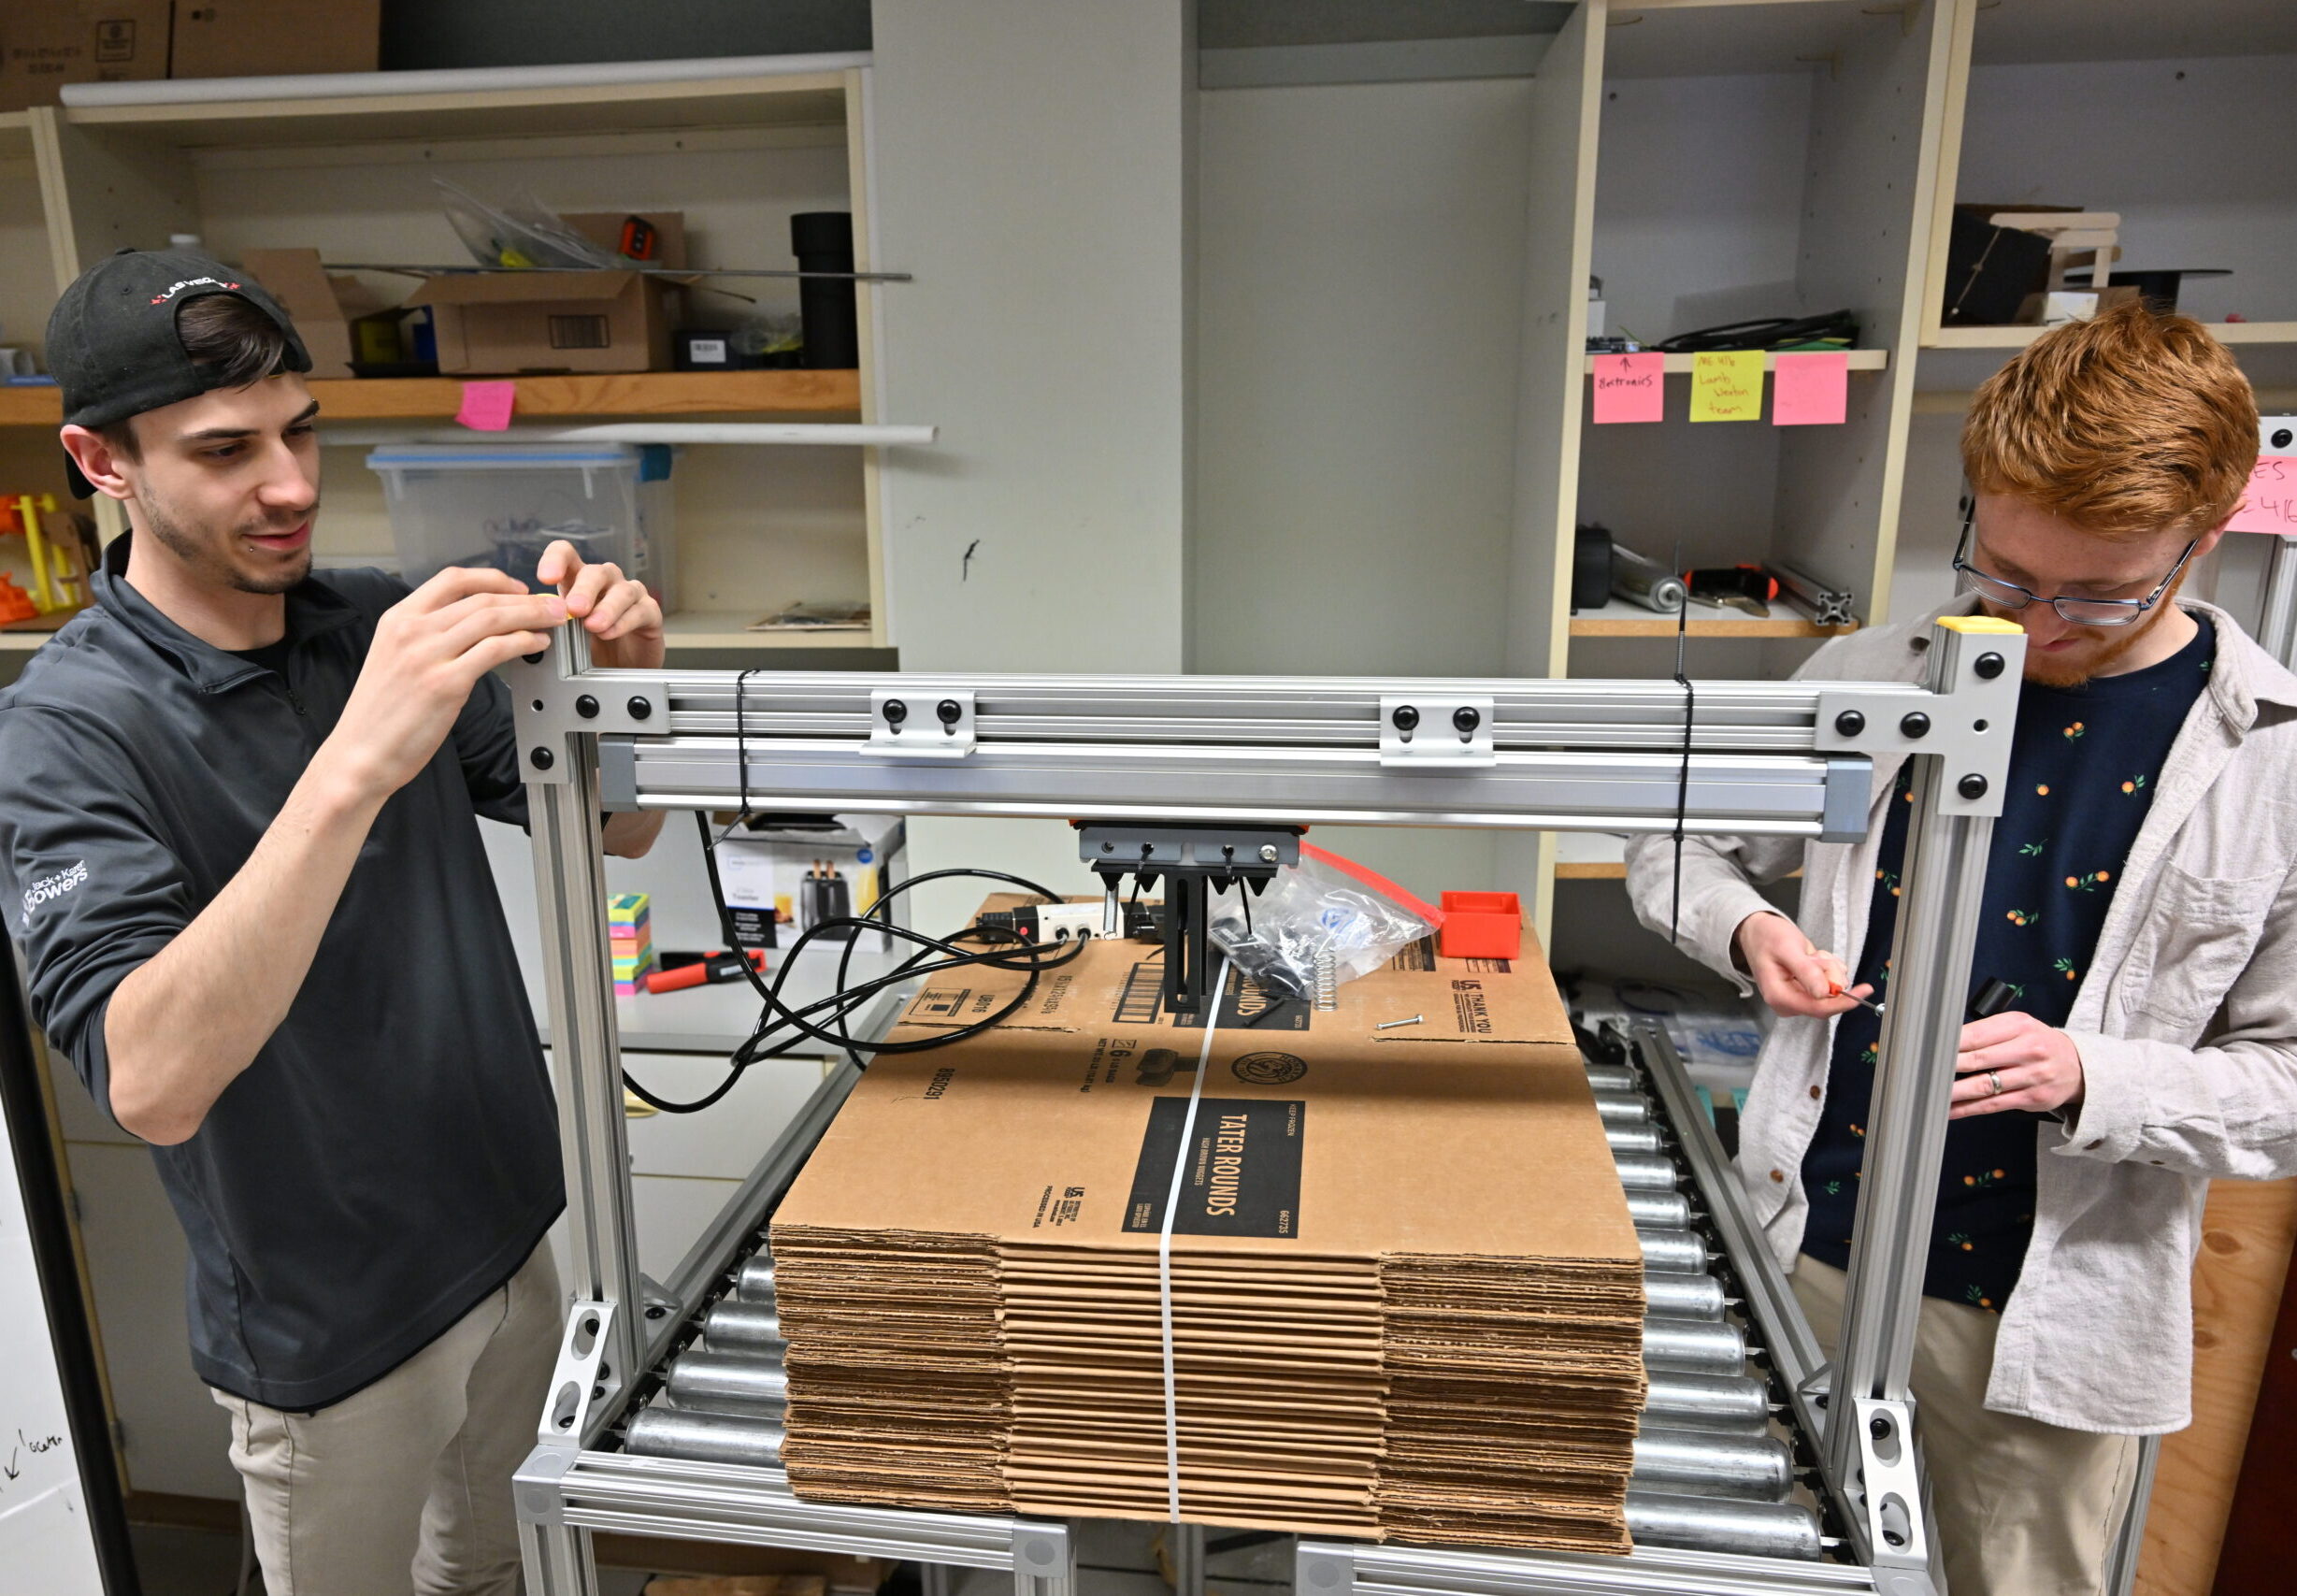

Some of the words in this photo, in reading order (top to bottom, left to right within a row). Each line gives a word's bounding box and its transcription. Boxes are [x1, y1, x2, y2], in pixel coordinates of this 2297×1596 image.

[161, 281, 186, 298] LAS
[32, 876, 55, 893] Jack
[1471, 994, 1488, 1016] THANK
[1475, 1018, 1492, 1033] YOU
[924, 1068, 955, 1100] 8950291
[1288, 1103, 1297, 1116] KEEP
[1215, 1114, 1248, 1153] TATER
[1287, 1116, 1296, 1136] FROZEN
[1206, 1156, 1242, 1216] ROUNDS
[1032, 1218, 1042, 1229] USA
[1278, 1210, 1290, 1234] 662735
